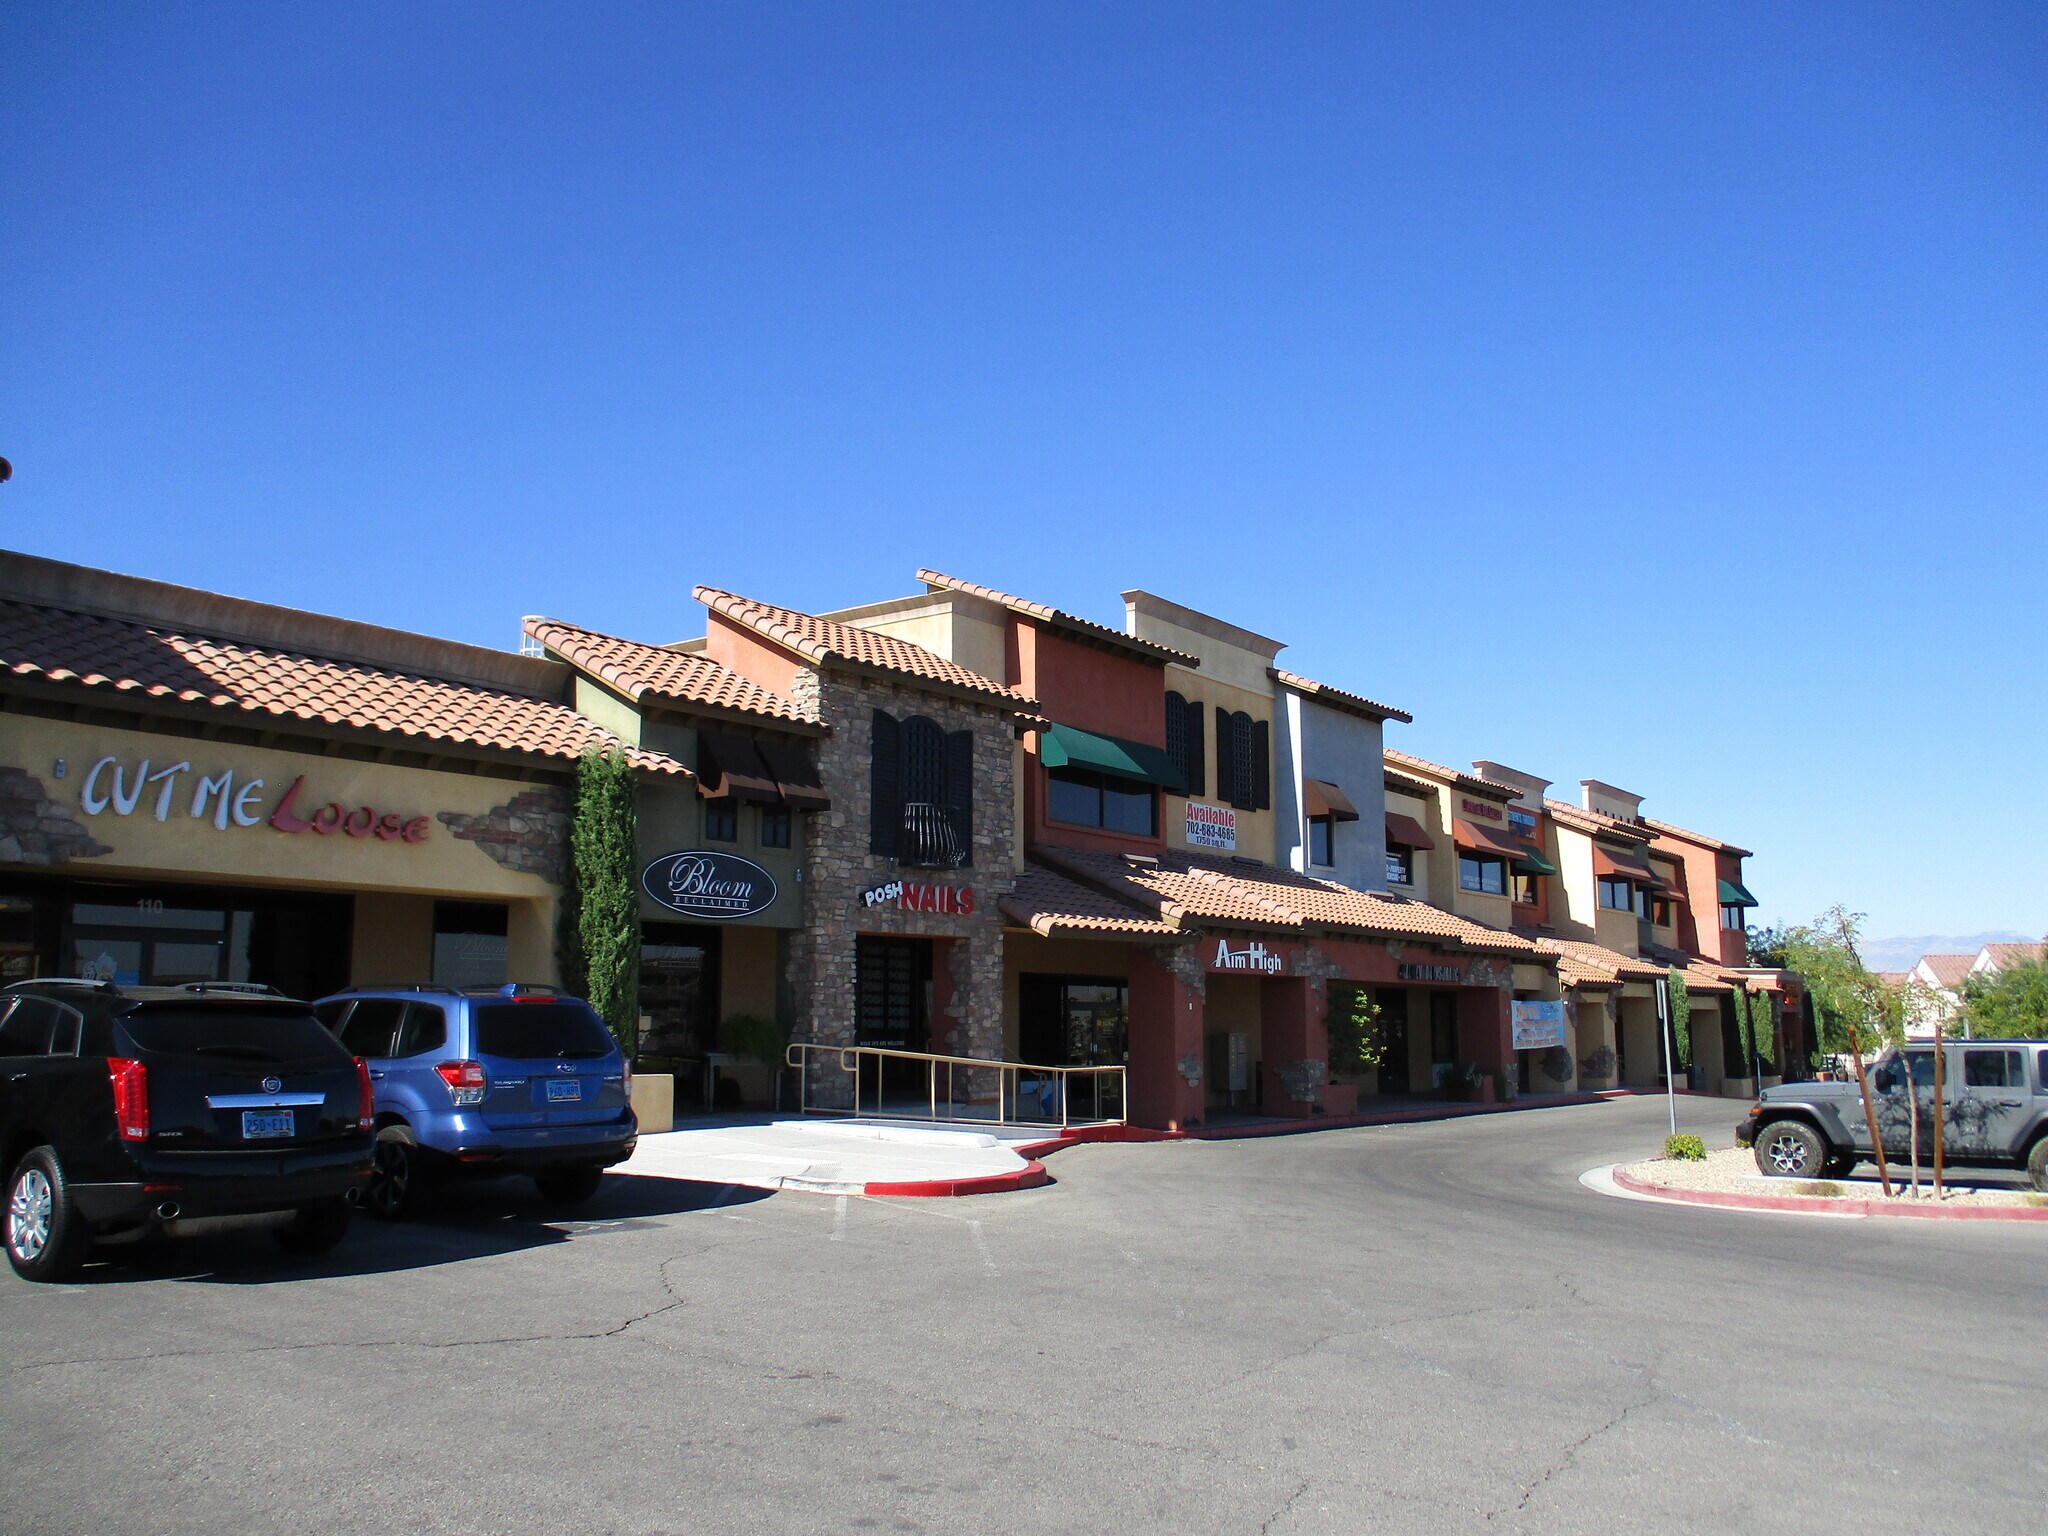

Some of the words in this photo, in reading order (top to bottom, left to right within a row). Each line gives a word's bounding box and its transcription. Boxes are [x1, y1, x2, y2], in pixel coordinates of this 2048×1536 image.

[81, 756, 191, 822] CUT
[190, 769, 265, 831] ME
[1187, 803, 1235, 828] Available
[1186, 821, 1235, 841] 702-683-4685
[668, 856, 754, 898] Bloom
[137, 898, 164, 914] 110
[675, 896, 749, 908] RECLAIMED
[865, 880, 904, 908] POSH
[897, 881, 975, 916] NAILS
[1215, 939, 1246, 969] Aim
[1249, 942, 1282, 975] High
